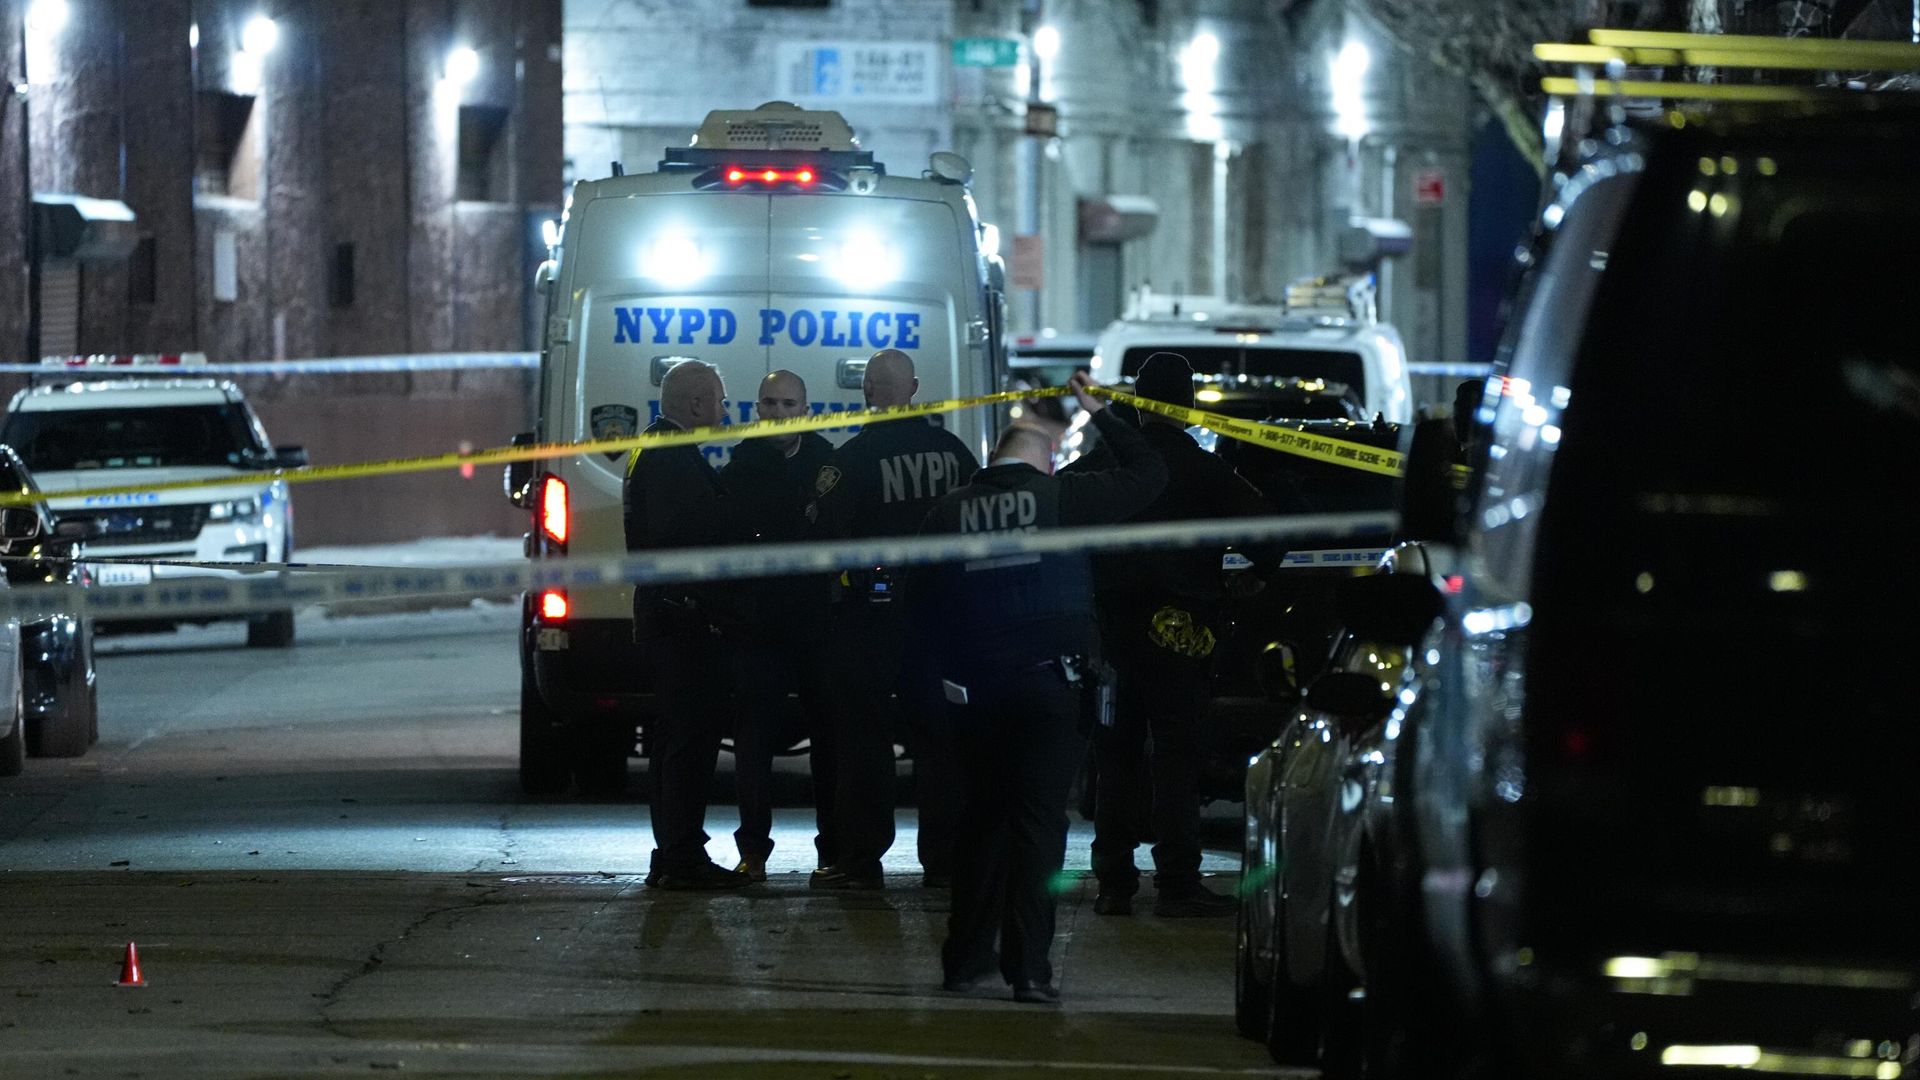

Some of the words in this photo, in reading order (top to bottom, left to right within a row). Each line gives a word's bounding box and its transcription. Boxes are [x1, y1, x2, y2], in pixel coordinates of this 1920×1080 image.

[614, 307, 736, 344] NYPD
[759, 309, 920, 348] POLICE
[1335, 446, 1357, 460] CRIME
[1358, 451, 1380, 465] SCENE
[880, 451, 960, 504] NYPD
[960, 491, 1037, 534] NYPD
